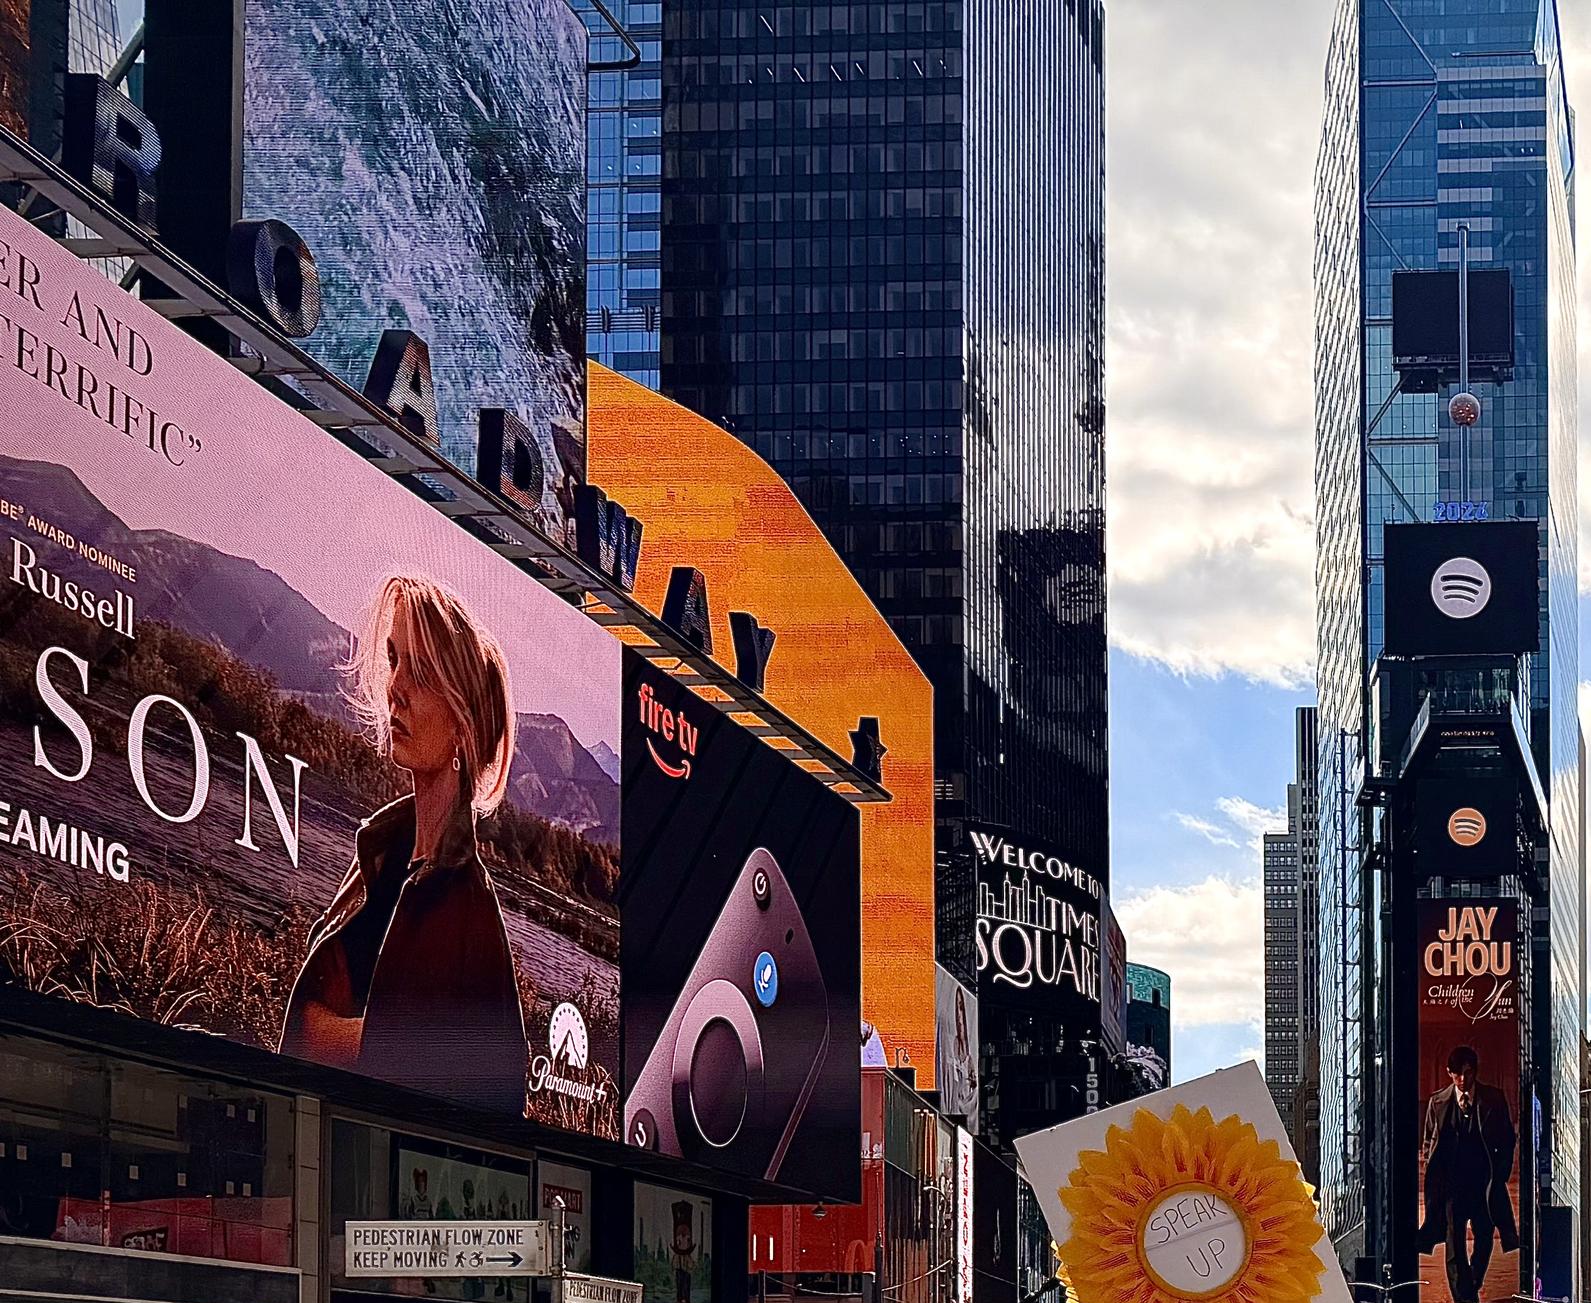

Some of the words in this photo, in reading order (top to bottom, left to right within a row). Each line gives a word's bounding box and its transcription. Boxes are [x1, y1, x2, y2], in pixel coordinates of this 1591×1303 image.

[60, 289, 153, 377] AND
[28, 515, 75, 549] AWARD
[79, 541, 136, 582] NOMINEE
[9, 537, 136, 640] Russell
[638, 682, 674, 741] fire
[678, 711, 698, 756] tv
[970, 831, 1085, 888] WELCOME
[1087, 873, 1100, 899] TO
[1046, 896, 1100, 950] TIMES
[1438, 906, 1498, 941] JAY
[976, 917, 1100, 1002] SQUARE
[1424, 941, 1511, 977] CHOU
[1428, 984, 1475, 998] Children
[353, 1228, 442, 1247] PEDESTRIAN
[446, 1229, 483, 1246] FLOW
[487, 1228, 524, 1246] ZONE
[1150, 1194, 1228, 1243] SPEAK
[353, 1251, 390, 1268] KEEP
[394, 1251, 447, 1269] MOVING
[1186, 1238, 1225, 1277] UP
[569, 1280, 604, 1301] PEDESTRIAN
[604, 1286, 622, 1303] FLOW
